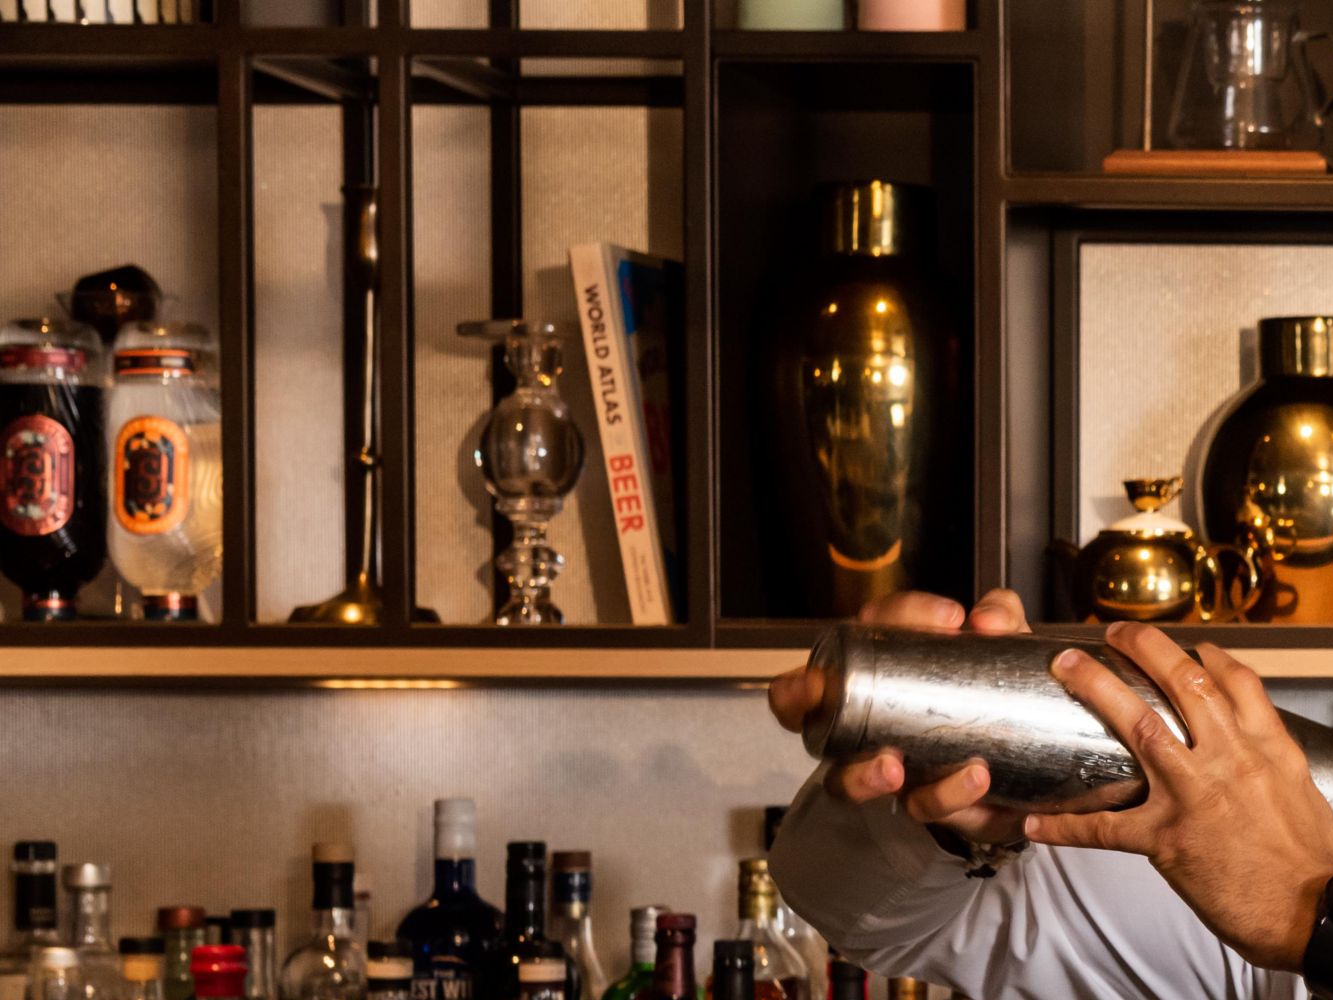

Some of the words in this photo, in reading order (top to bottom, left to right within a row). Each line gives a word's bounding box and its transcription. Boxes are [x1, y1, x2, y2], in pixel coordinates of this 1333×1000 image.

[585, 283, 611, 361] WORLD
[598, 365, 623, 427] ATLAS
[609, 453, 644, 535] BEER
